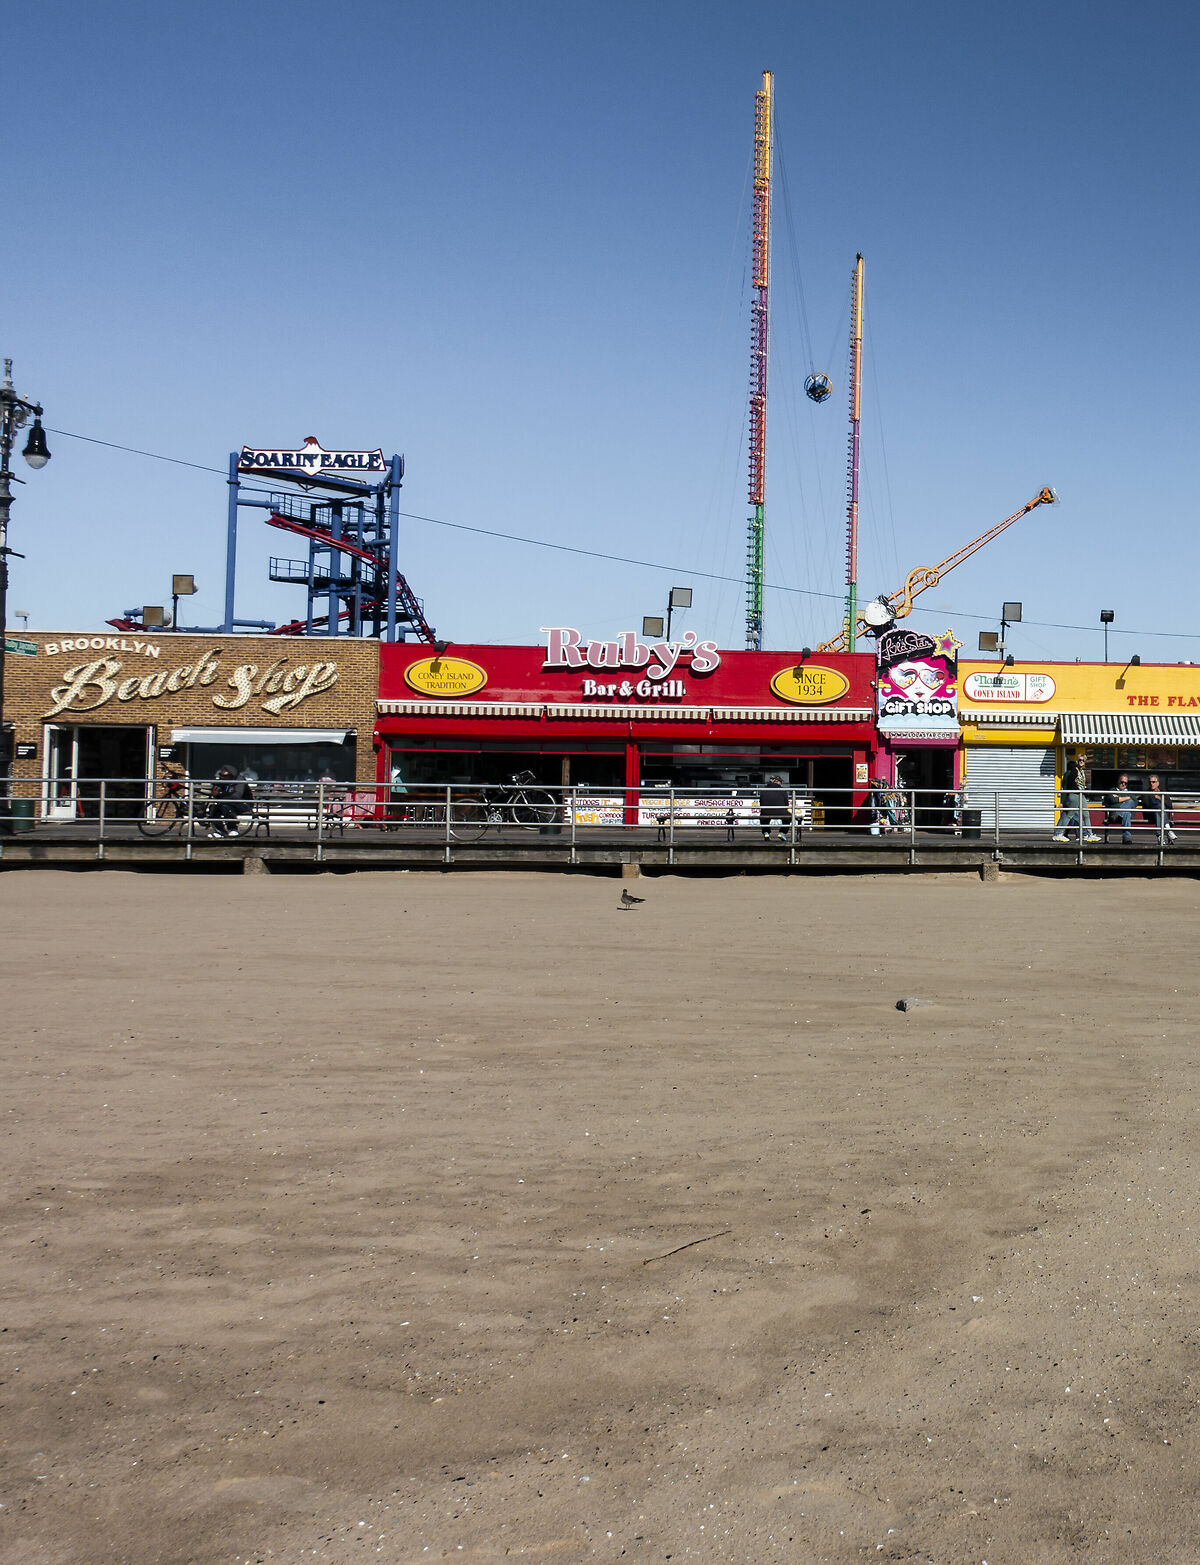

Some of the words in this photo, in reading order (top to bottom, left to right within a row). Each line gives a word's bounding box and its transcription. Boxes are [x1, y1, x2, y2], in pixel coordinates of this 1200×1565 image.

[321, 454, 382, 469] EAGLE
[45, 637, 160, 658] BROOKLYN
[882, 638, 907, 661] Lola
[904, 633, 932, 651] Star
[540, 627, 722, 680] Ruby's
[40, 647, 224, 718] Beach
[212, 656, 340, 716] Shop
[794, 673, 826, 685] SINCE
[973, 675, 1019, 686] Nathan's
[582, 679, 616, 696] Bar
[619, 681, 635, 697] &
[636, 679, 684, 697] Grill
[797, 685, 823, 696] 1934
[973, 690, 995, 698] CONEY
[997, 690, 1020, 699] ISLAND
[1127, 696, 1160, 706] THE
[917, 703, 951, 714] SHOP
[665, 799, 690, 807] BRGER
[694, 799, 725, 807] SAUSAGE
[726, 799, 744, 807] HERO
